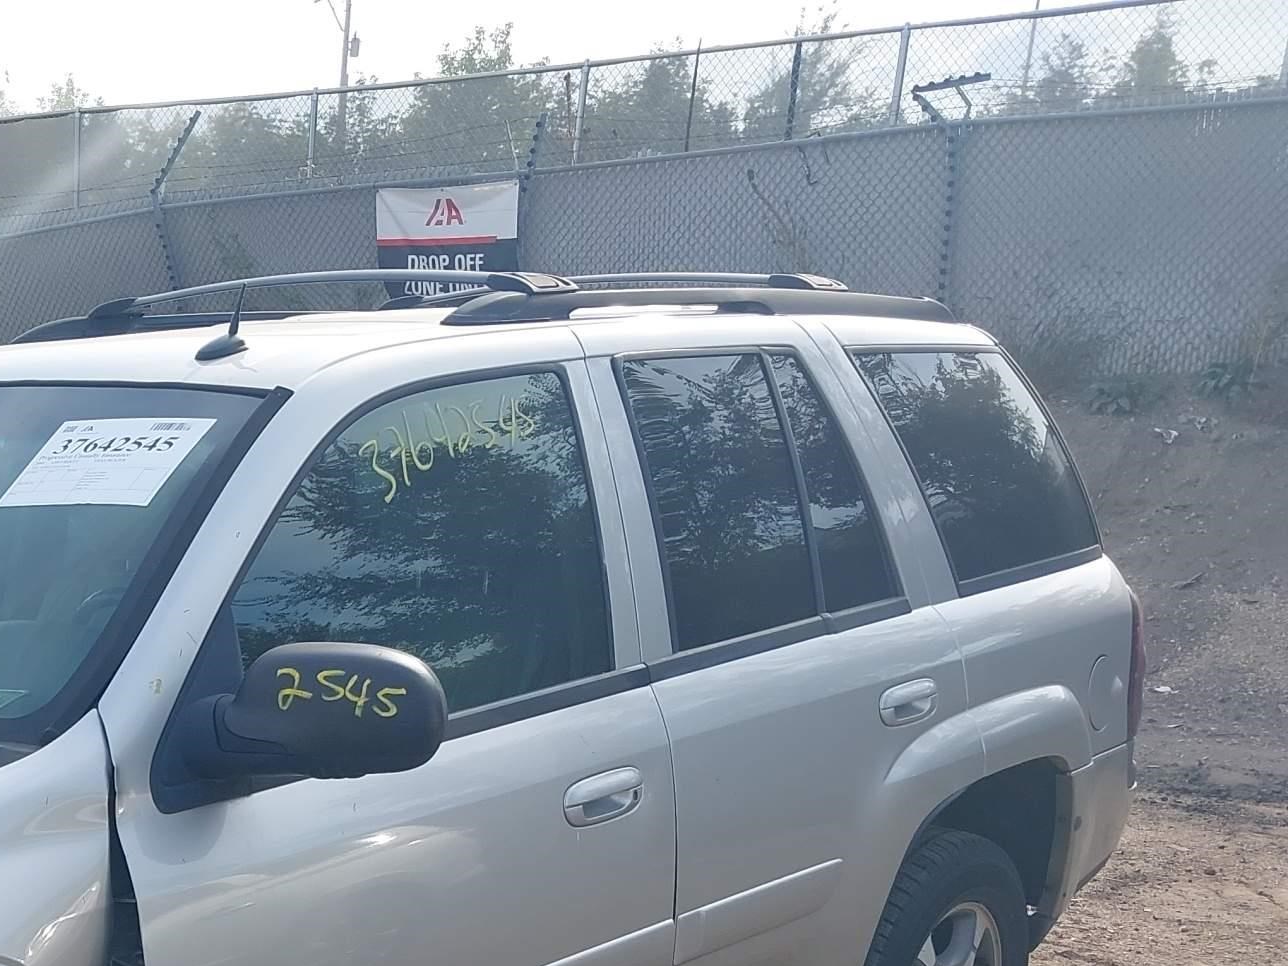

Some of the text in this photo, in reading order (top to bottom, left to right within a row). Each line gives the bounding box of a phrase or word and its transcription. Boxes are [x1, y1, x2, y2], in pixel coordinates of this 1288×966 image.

[407, 253, 485, 272] DROP OFF
[52, 436, 180, 455] 37642545
[277, 667, 407, 718] 2545
